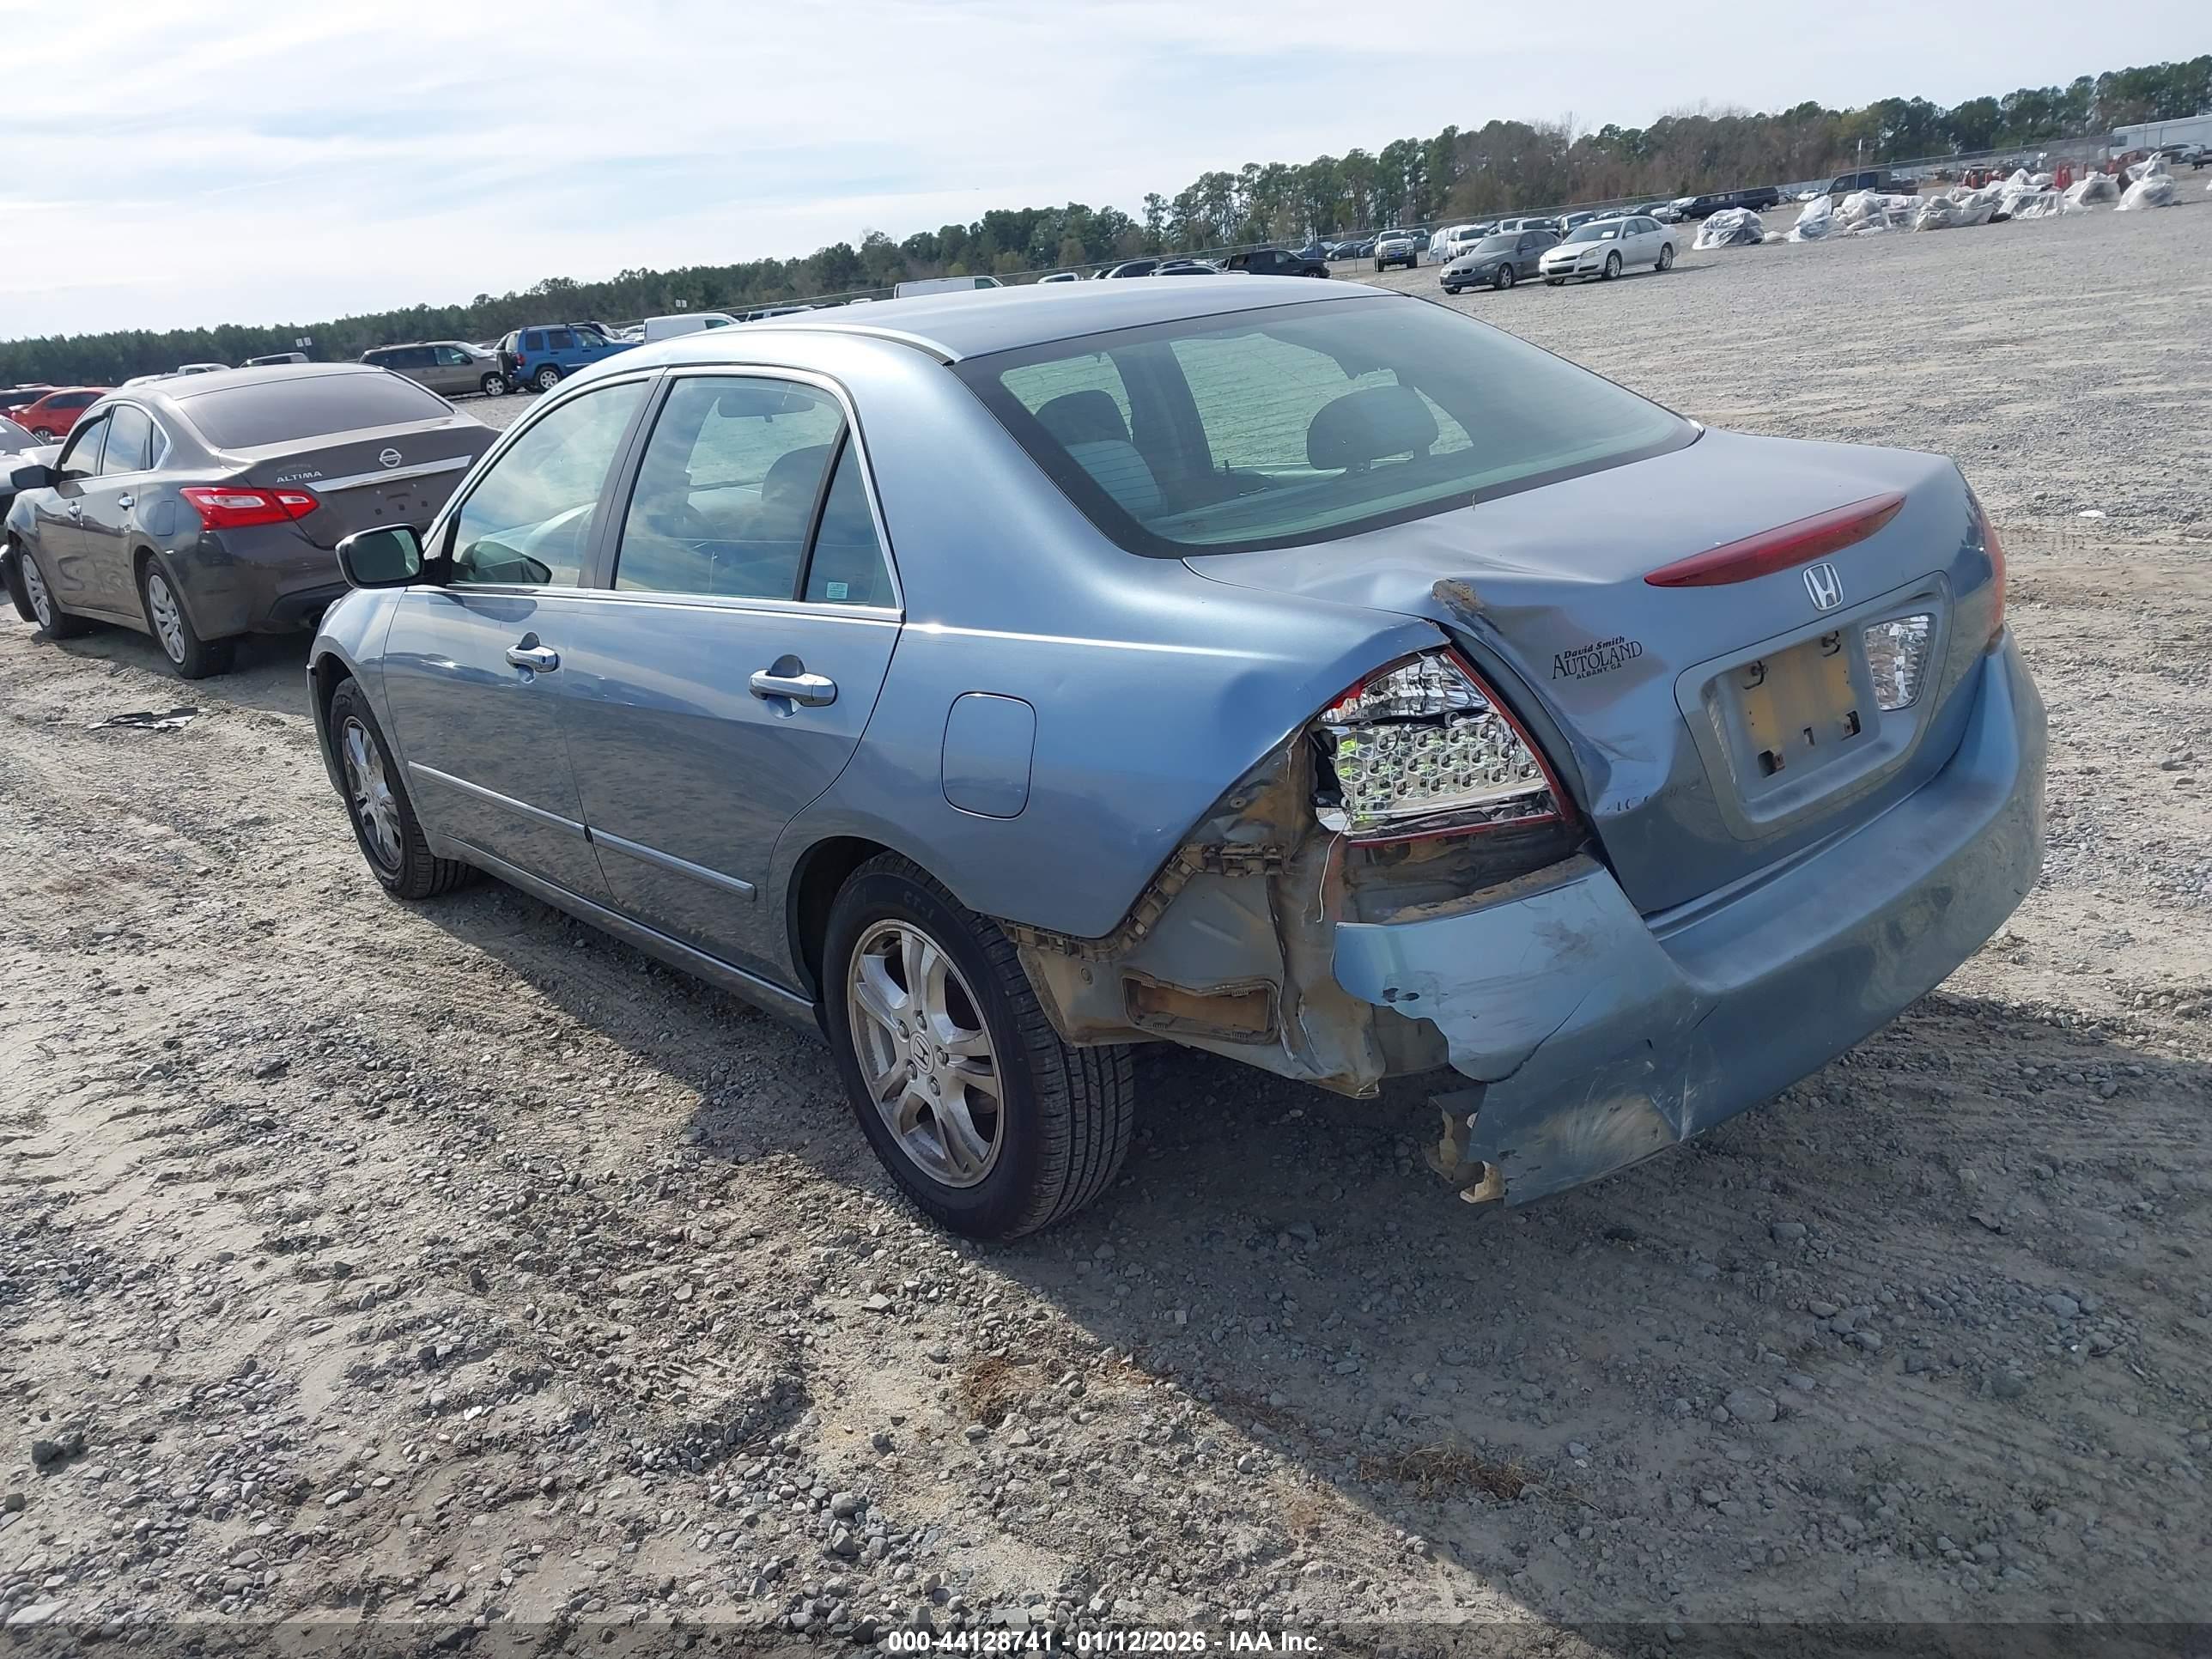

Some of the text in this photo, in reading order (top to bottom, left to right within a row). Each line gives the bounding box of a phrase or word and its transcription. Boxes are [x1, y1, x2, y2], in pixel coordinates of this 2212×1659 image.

[276, 471, 323, 483] ALTIMA
[1564, 635, 1626, 659] David Smith
[1553, 641, 1643, 680] AUTOLAND
[1576, 662, 1622, 680] ALBANY, GA
